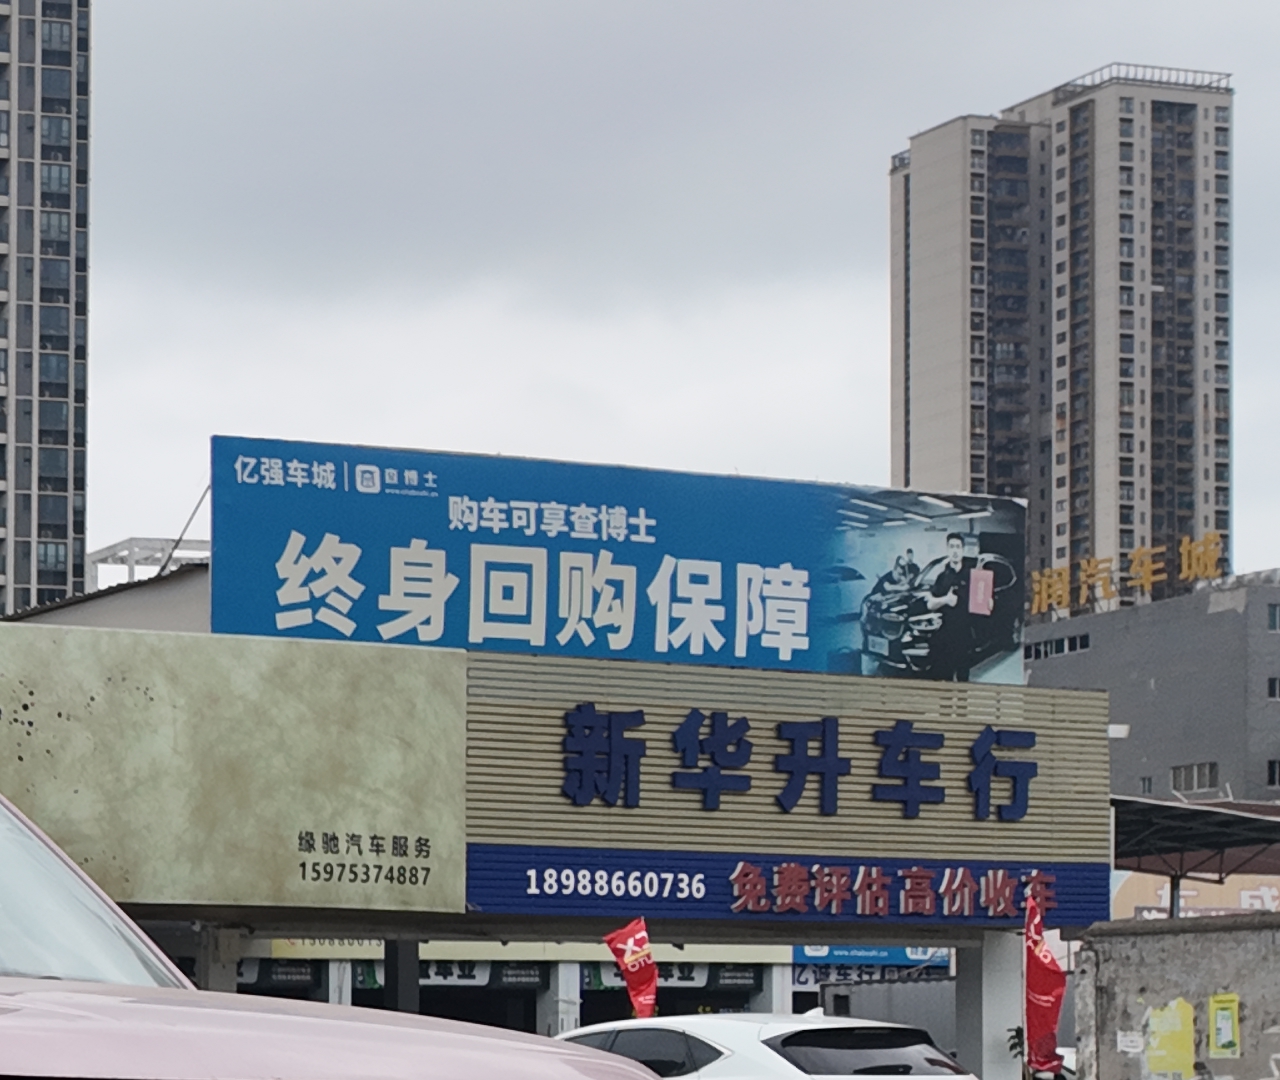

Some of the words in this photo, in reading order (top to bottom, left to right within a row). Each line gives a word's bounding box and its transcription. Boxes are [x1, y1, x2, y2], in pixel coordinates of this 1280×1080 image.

[234, 455, 336, 490] 亿强车城
[448, 494, 657, 544] 购车可享查博士
[274, 529, 811, 662] 终身回购保障
[561, 702, 1038, 823] 新华升车行
[297, 830, 432, 859] 缘驰汽车服务
[298, 860, 432, 886] 15975374887
[526, 867, 706, 899] 18988660736
[728, 861, 1056, 918] 免费评估高价收车
